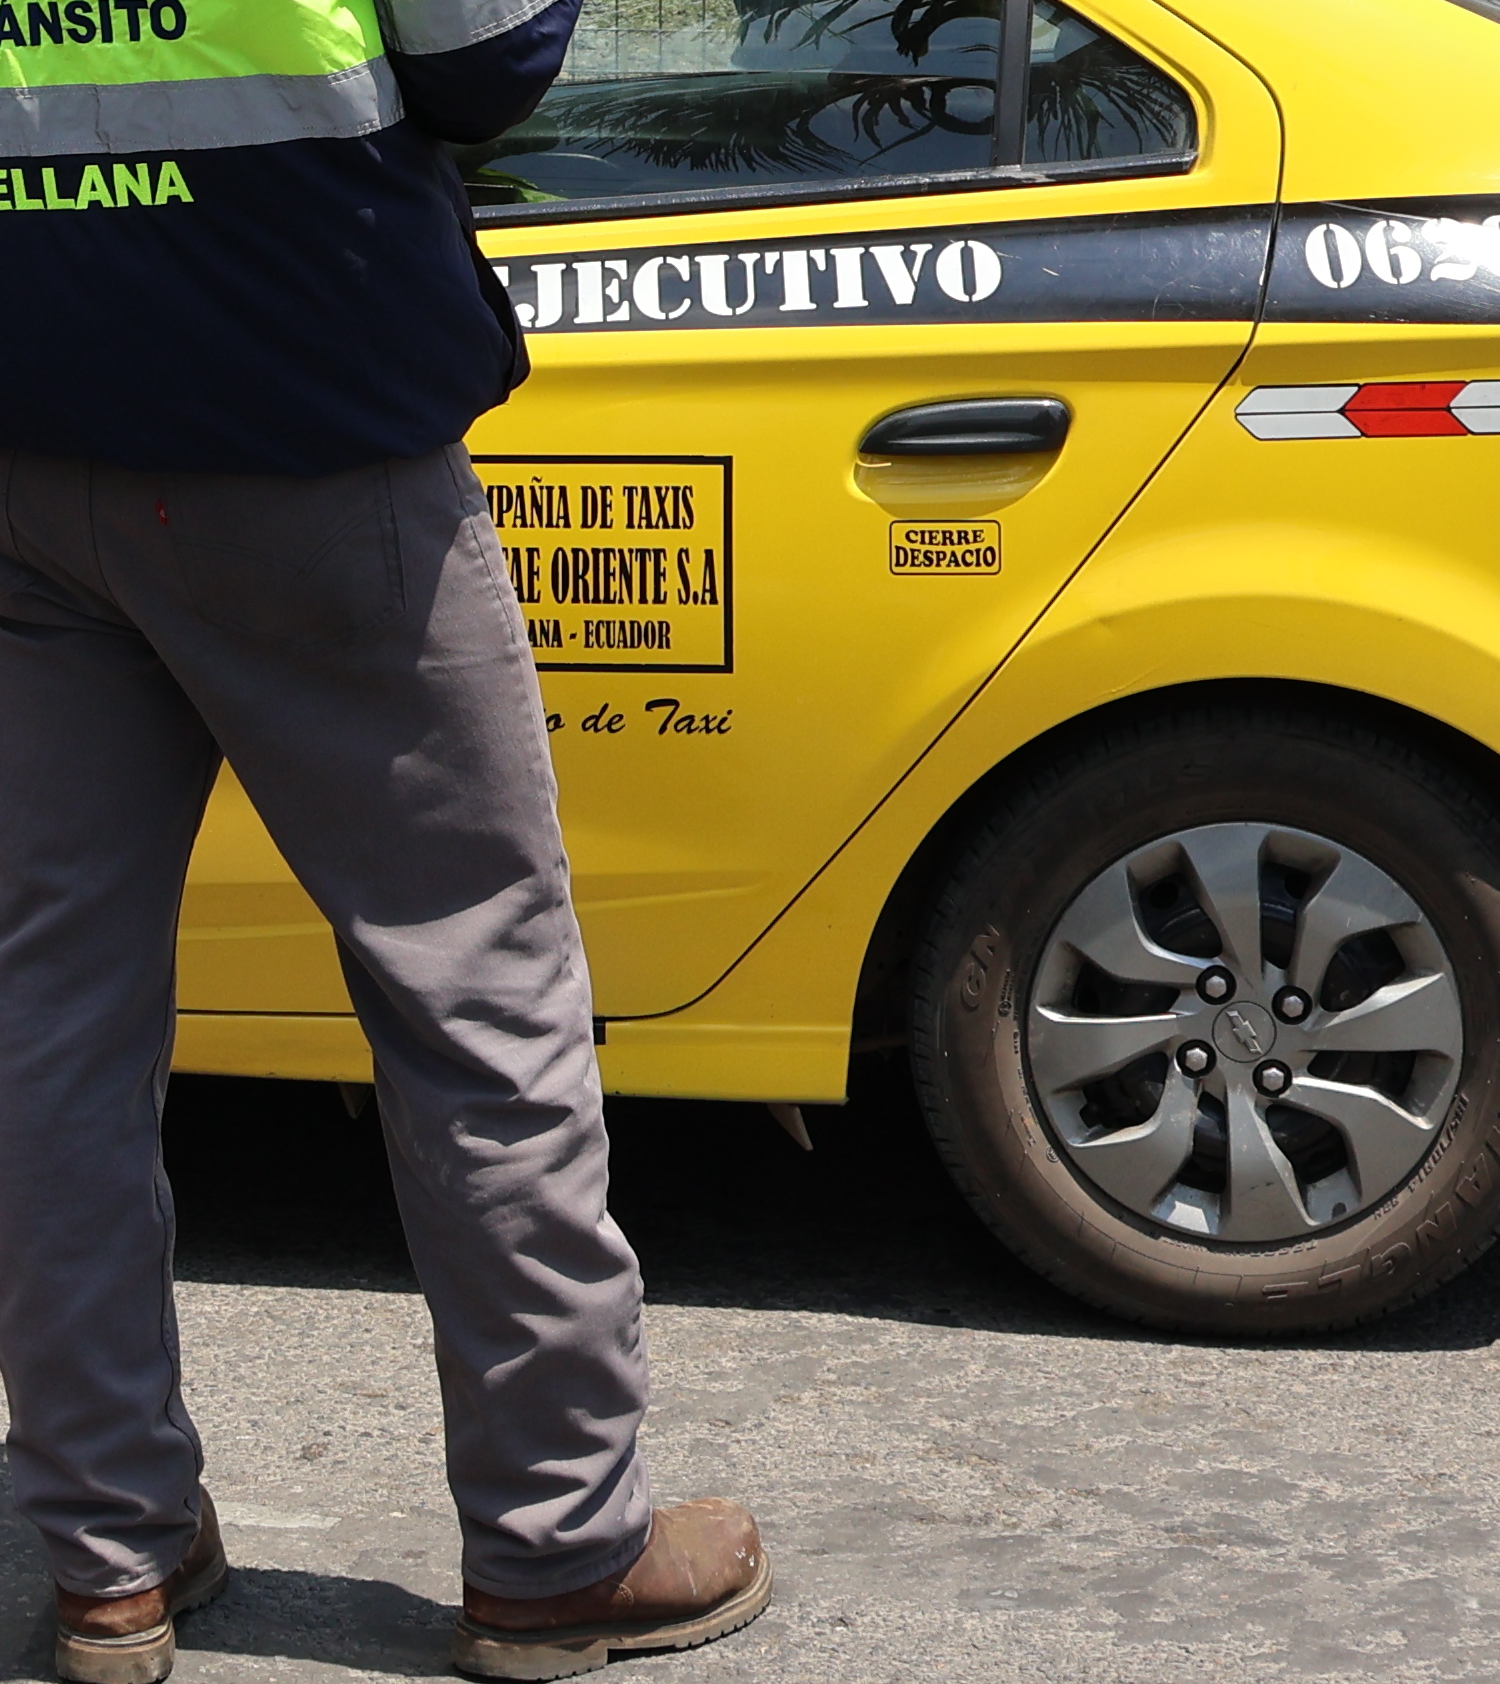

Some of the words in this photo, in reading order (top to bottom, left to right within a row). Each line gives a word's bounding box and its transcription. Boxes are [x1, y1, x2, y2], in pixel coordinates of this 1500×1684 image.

[496, 240, 1003, 329] JECUTIVO
[580, 485, 614, 529] DE
[623, 485, 694, 530] TAXIS
[904, 528, 985, 546] CIERRE
[894, 544, 997, 570] DESPACIO
[551, 547, 668, 605] ORIENTE
[677, 547, 719, 606] S.A
[584, 620, 672, 649] ECUADOR
[581, 703, 626, 734] de
[645, 698, 734, 736] Taxi
